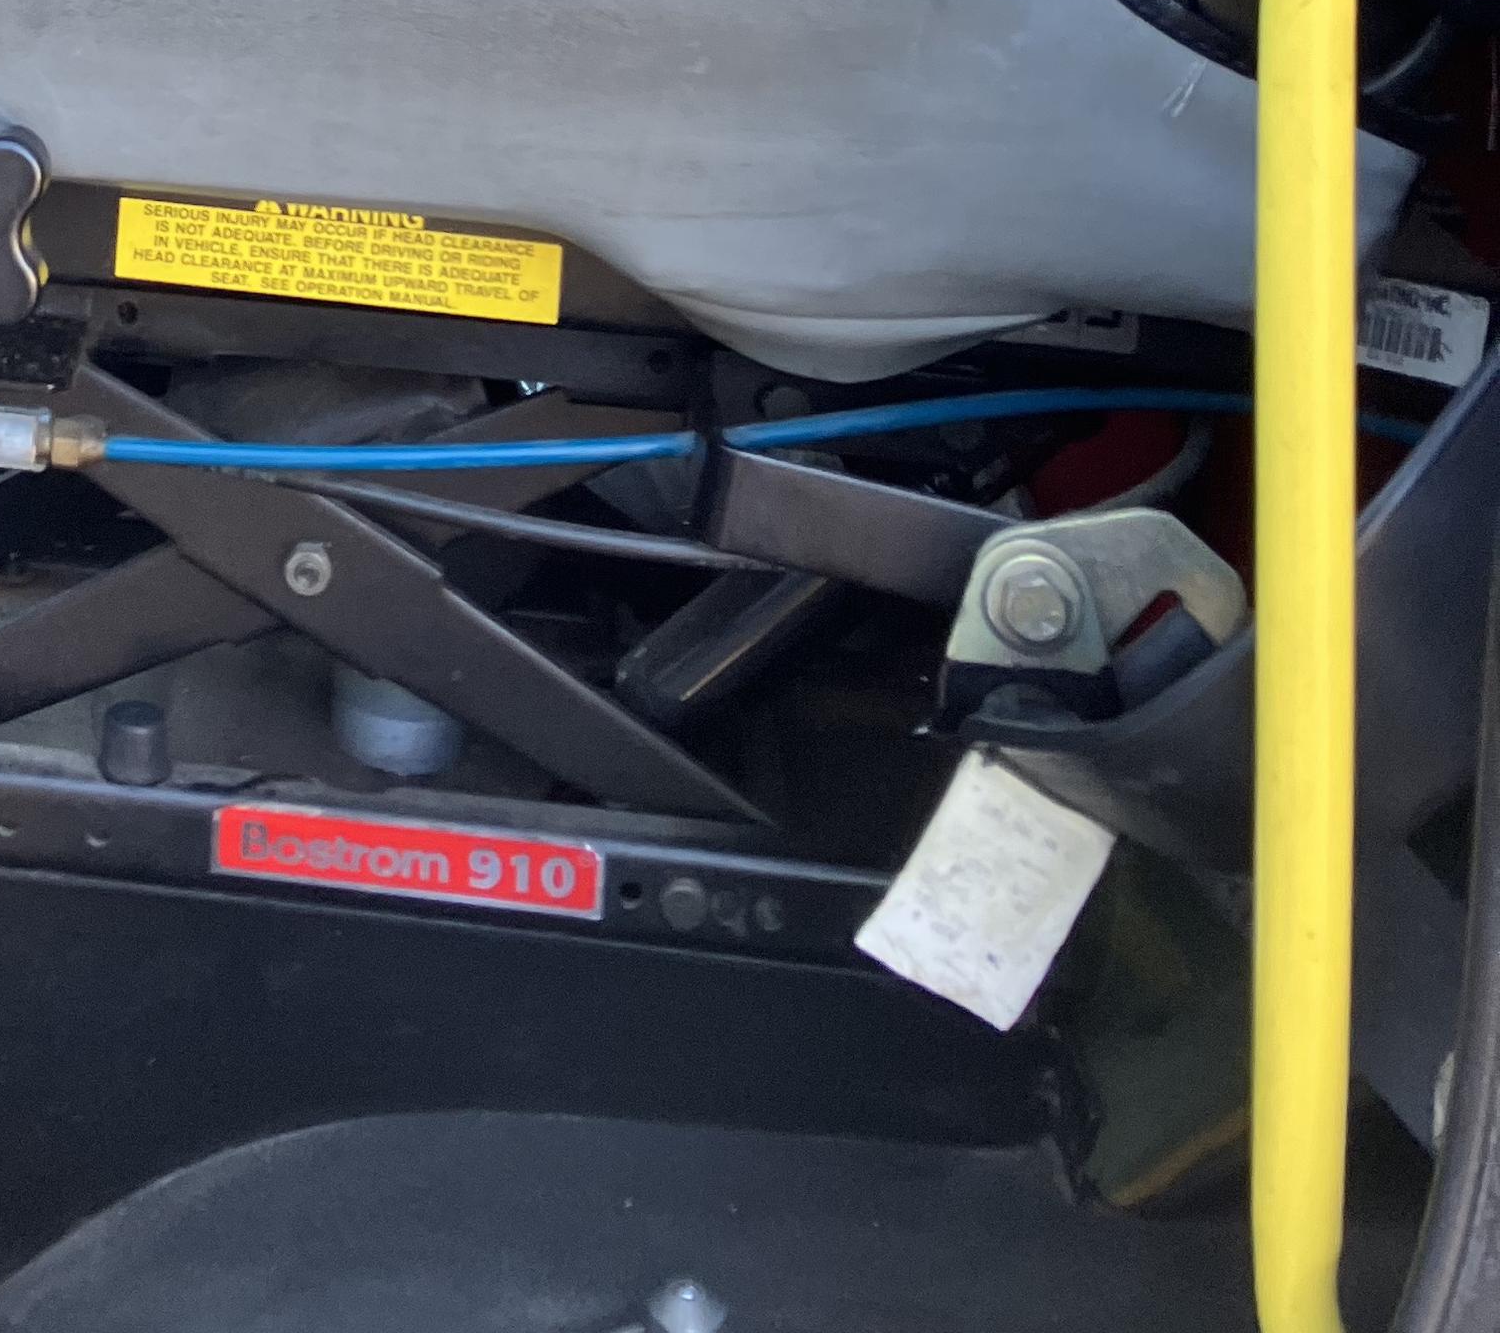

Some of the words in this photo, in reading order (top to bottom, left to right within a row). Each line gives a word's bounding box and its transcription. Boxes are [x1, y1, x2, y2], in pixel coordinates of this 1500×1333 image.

[144, 203, 209, 221] SERIOUS
[216, 211, 269, 228] INJURY
[276, 217, 306, 232] MAY
[314, 221, 366, 238] OCCUR
[373, 227, 386, 240] IF
[392, 229, 434, 245] HEAD
[441, 235, 534, 256] CLEARANCE
[156, 220, 168, 232] IS
[176, 222, 204, 236] NOT
[304, 235, 363, 253] BEFORE
[371, 242, 433, 260] DRIVING
[439, 250, 461, 263] OR
[467, 253, 520, 269] RIDING
[133, 248, 174, 264] HEAD
[181, 253, 271, 274] CLEARANCE
[279, 263, 296, 276] AT
[303, 266, 375, 285] MAXIMUM
[383, 274, 448, 292] UPWARD
[455, 282, 511, 299] TRAVEL
[518, 288, 539, 302] OF
[154, 235, 167, 248] IN
[250, 245, 311, 263] ENSURE
[319, 252, 355, 268] THAT
[364, 257, 411, 273] THERE
[418, 263, 432, 276] IS
[438, 265, 519, 285] ADEQUATE
[261, 276, 288, 291] SEE
[296, 280, 381, 300] OPERATION
[240, 820, 450, 885] Bostrom
[467, 848, 576, 899] 910
